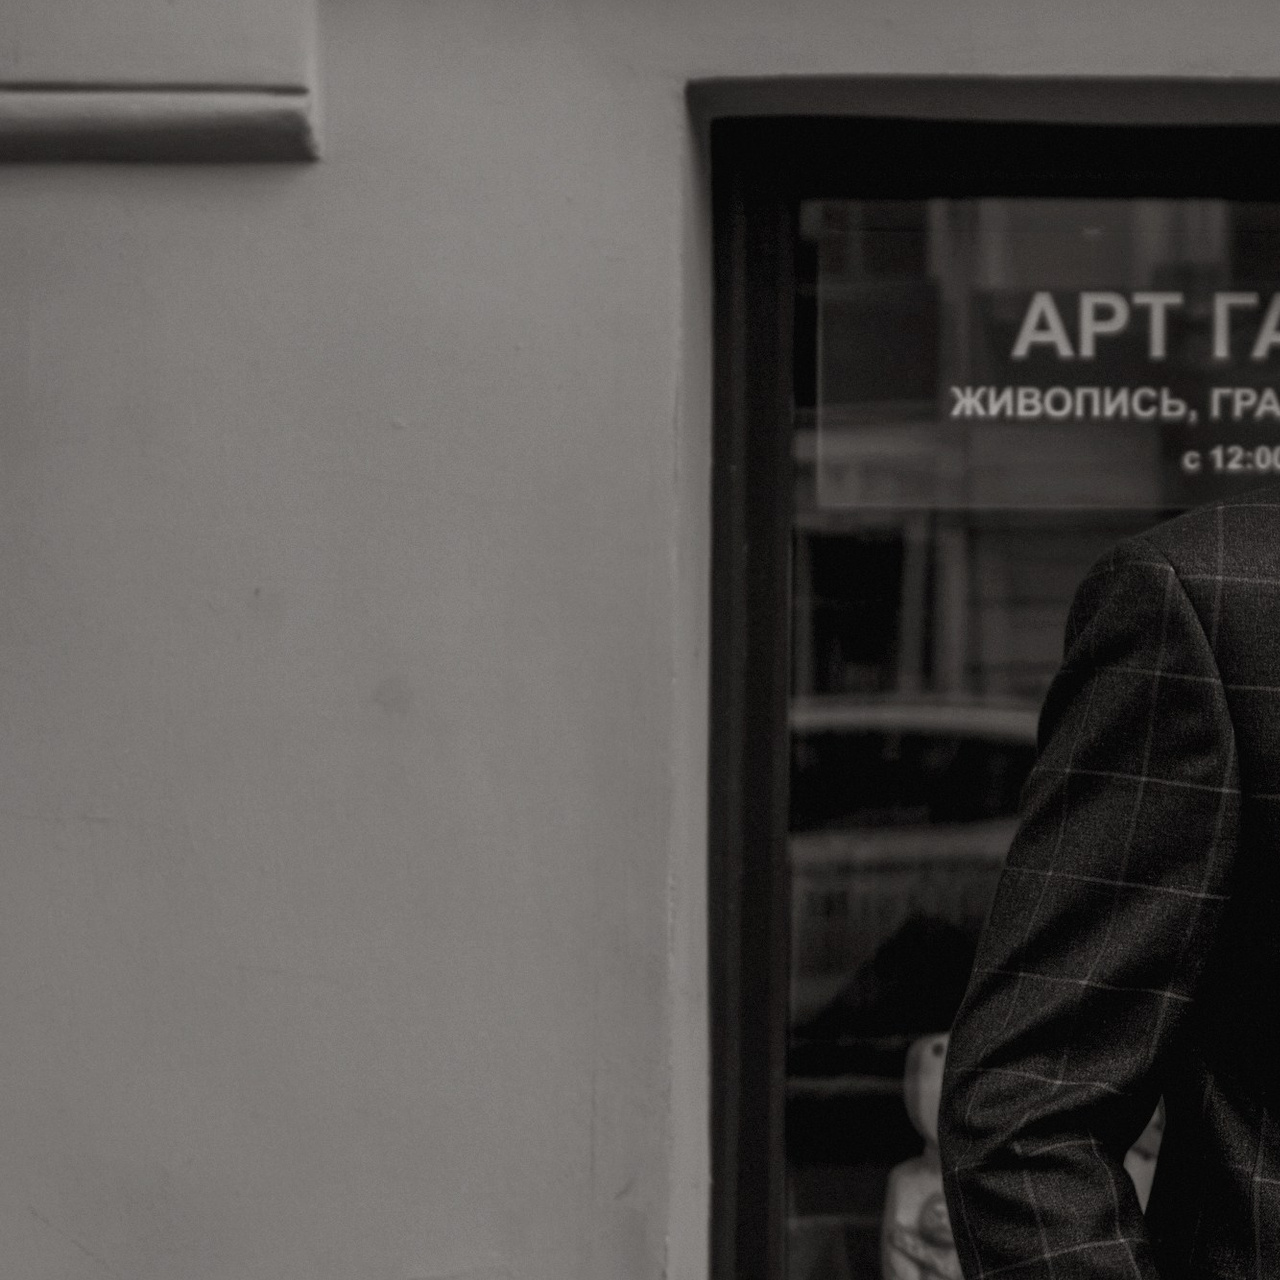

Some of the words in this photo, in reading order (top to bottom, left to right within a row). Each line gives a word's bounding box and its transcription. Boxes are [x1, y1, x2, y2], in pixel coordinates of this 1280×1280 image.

[1011, 291, 1184, 360] АРТ
[950, 386, 1198, 423] ЖИВОПИСЬ,
[1182, 450, 1200, 471] с
